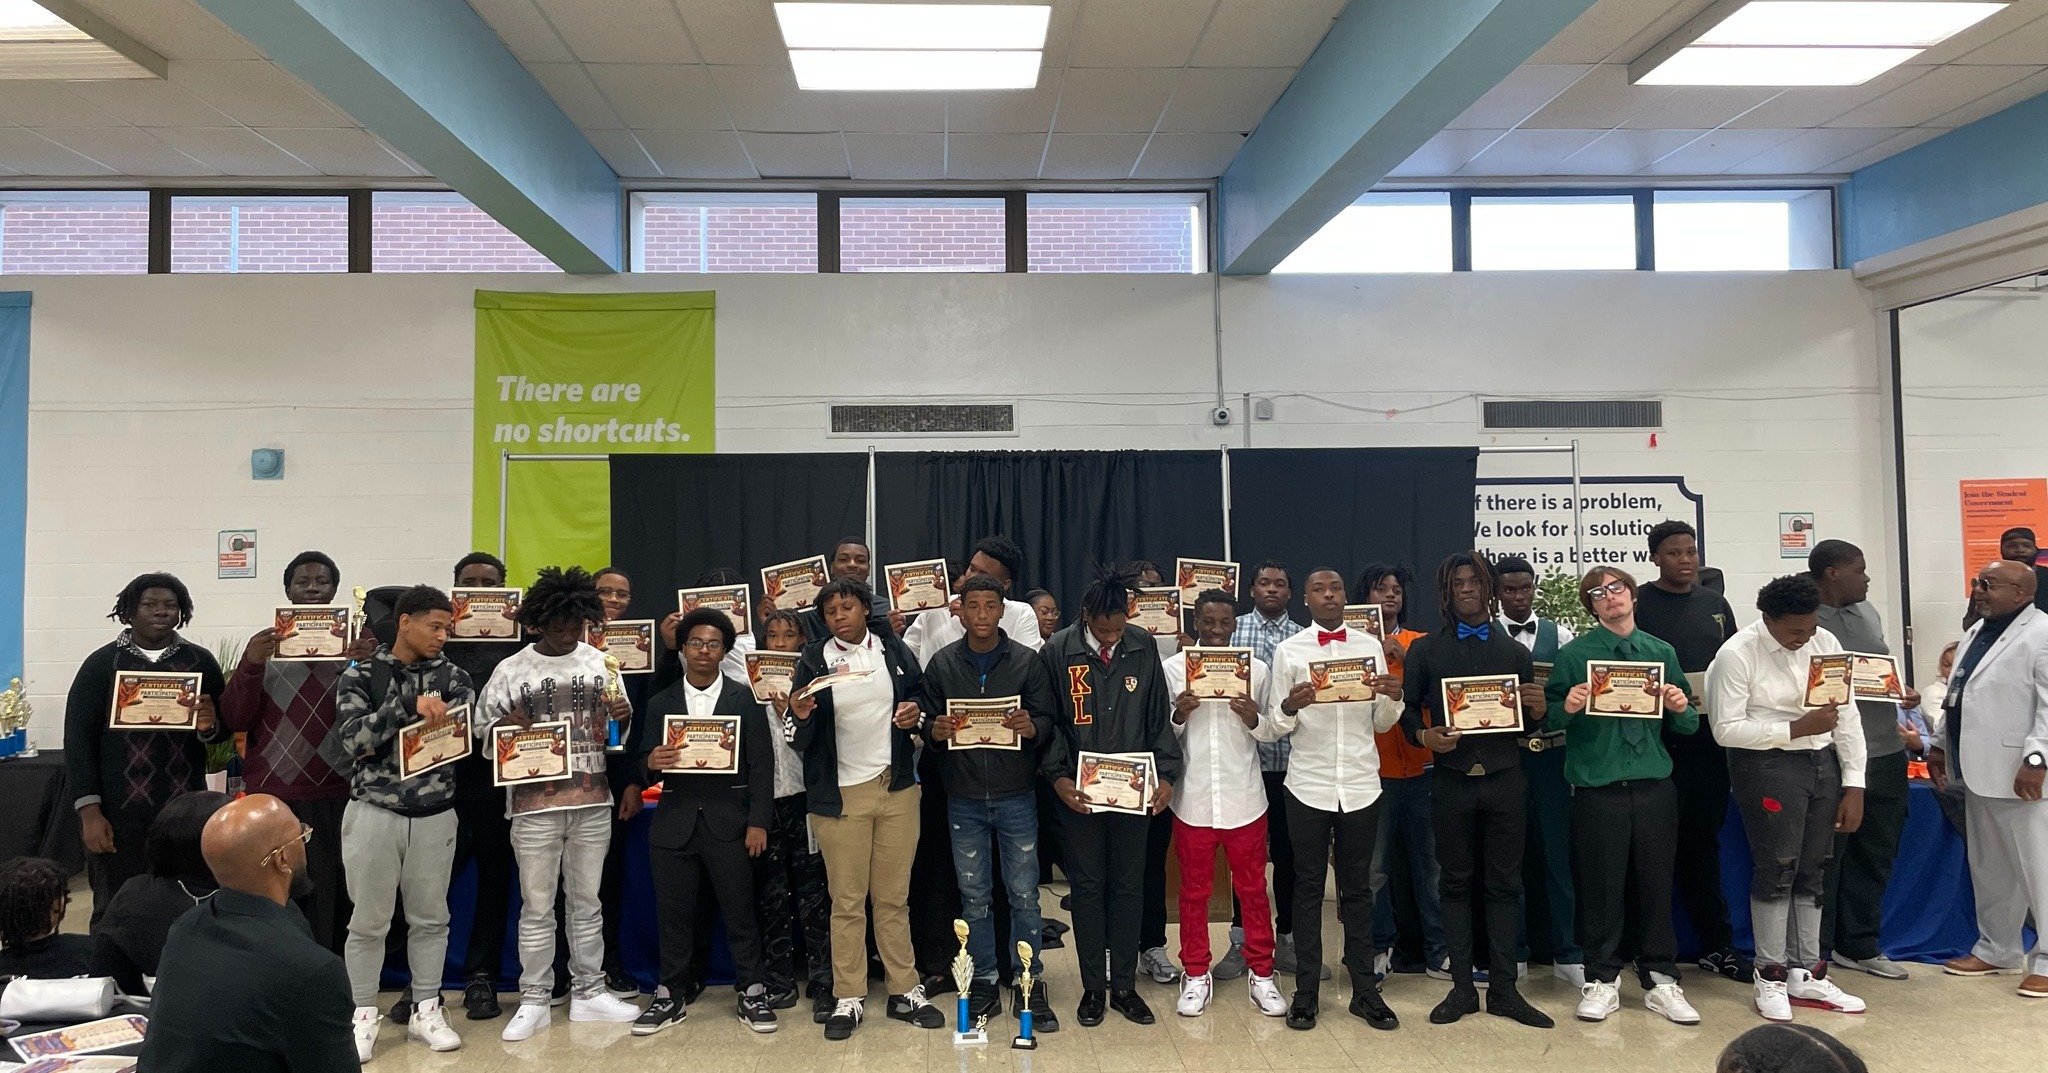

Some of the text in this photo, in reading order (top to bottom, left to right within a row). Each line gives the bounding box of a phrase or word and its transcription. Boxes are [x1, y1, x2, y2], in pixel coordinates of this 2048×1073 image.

[496, 375, 641, 402] There are
[493, 416, 691, 443] no shortcuts.
[1486, 493, 1537, 511] there
[1541, 493, 1558, 510] is
[1562, 497, 1573, 510] a
[1580, 492, 1662, 513] problem,
[1964, 499, 2013, 507] Government
[1496, 520, 1537, 538] look
[1541, 519, 1569, 537] for
[1589, 518, 1653, 536] solutio
[1532, 546, 1548, 563] is
[1553, 551, 1564, 563] a
[1569, 546, 1627, 563] better
[1327, 664, 1364, 673] CERTIFICATE
[139, 682, 183, 690] CERTIFICATE
[1068, 664, 1092, 695] K
[1463, 685, 1502, 693] CERTIFICATE
[1072, 694, 1093, 725] L
[514, 732, 554, 741] CERTIFICATE
